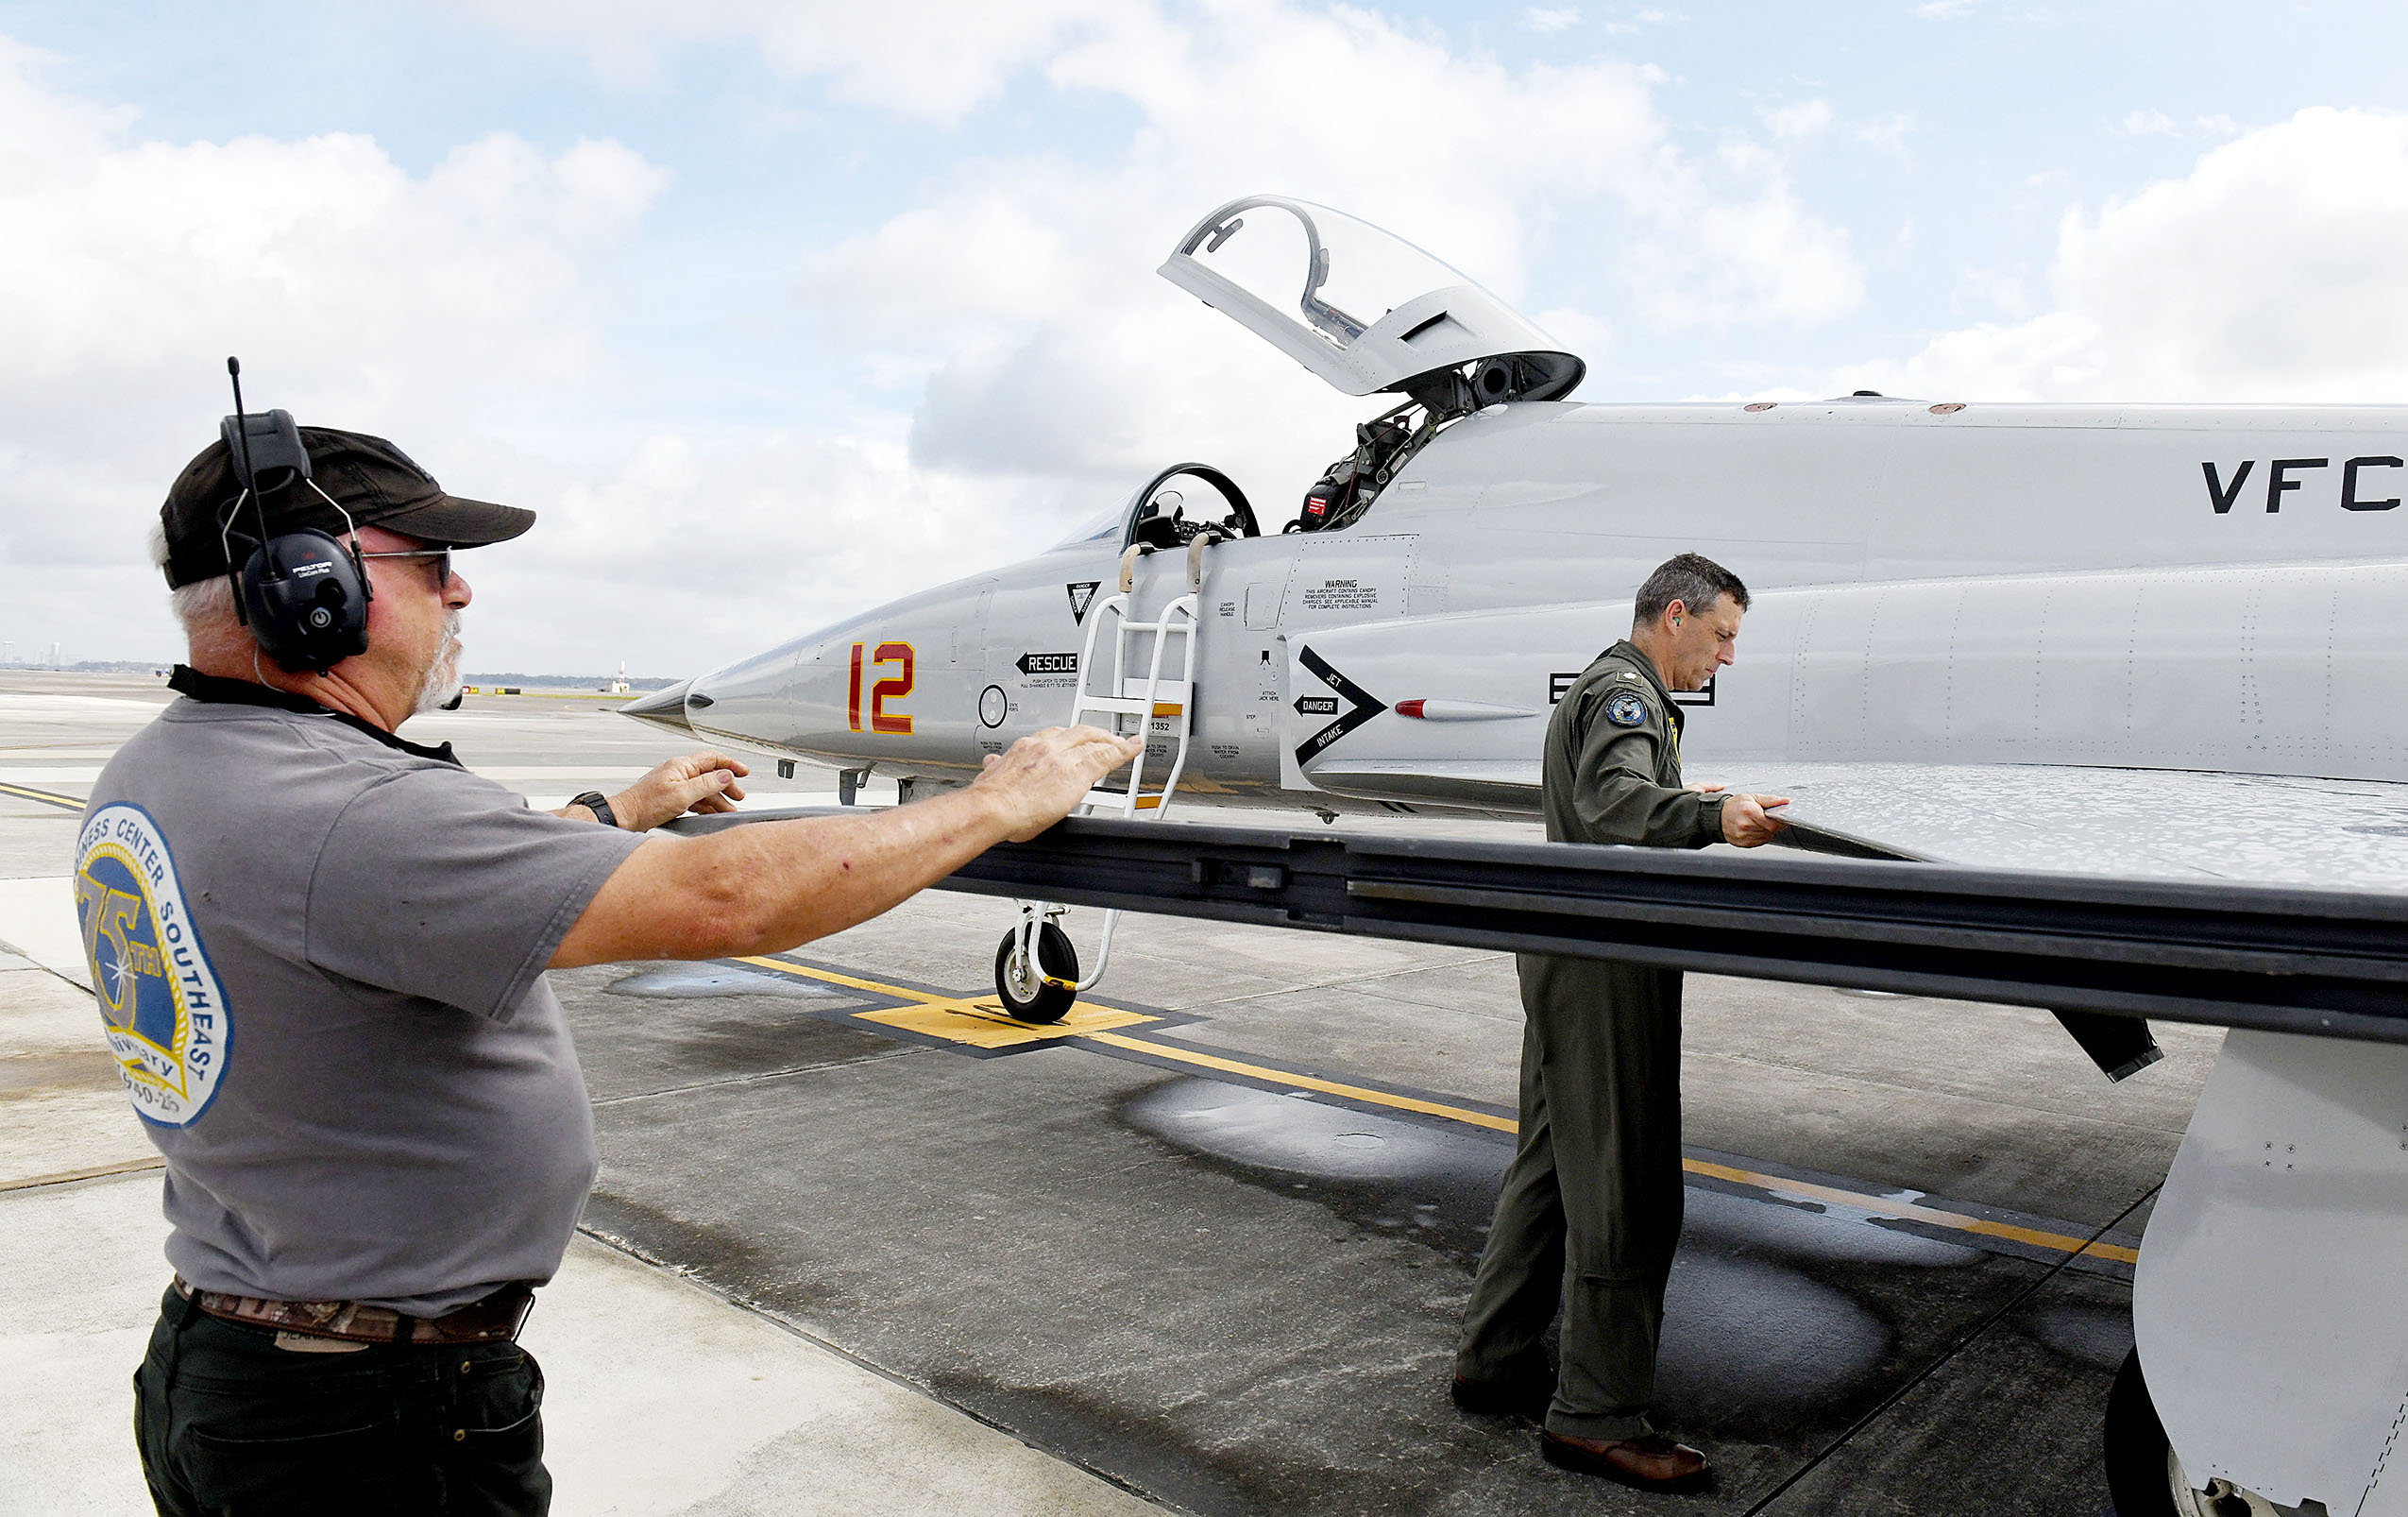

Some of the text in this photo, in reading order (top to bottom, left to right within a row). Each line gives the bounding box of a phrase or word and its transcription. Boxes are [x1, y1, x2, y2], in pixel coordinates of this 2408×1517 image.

[2201, 456, 2404, 514] VFC
[293, 561, 332, 573] PELTOR
[1325, 579, 1358, 588] WARNING
[1028, 656, 1077, 672] RESCUE
[1326, 673, 1342, 688] JET
[848, 641, 915, 736] 12
[1303, 701, 1333, 711] DANGER
[1151, 722, 1170, 731] 1352
[1316, 724, 1344, 747] INTAKE
[116, 818, 163, 888] CENTER
[160, 900, 212, 1082] SOUTHEAST
